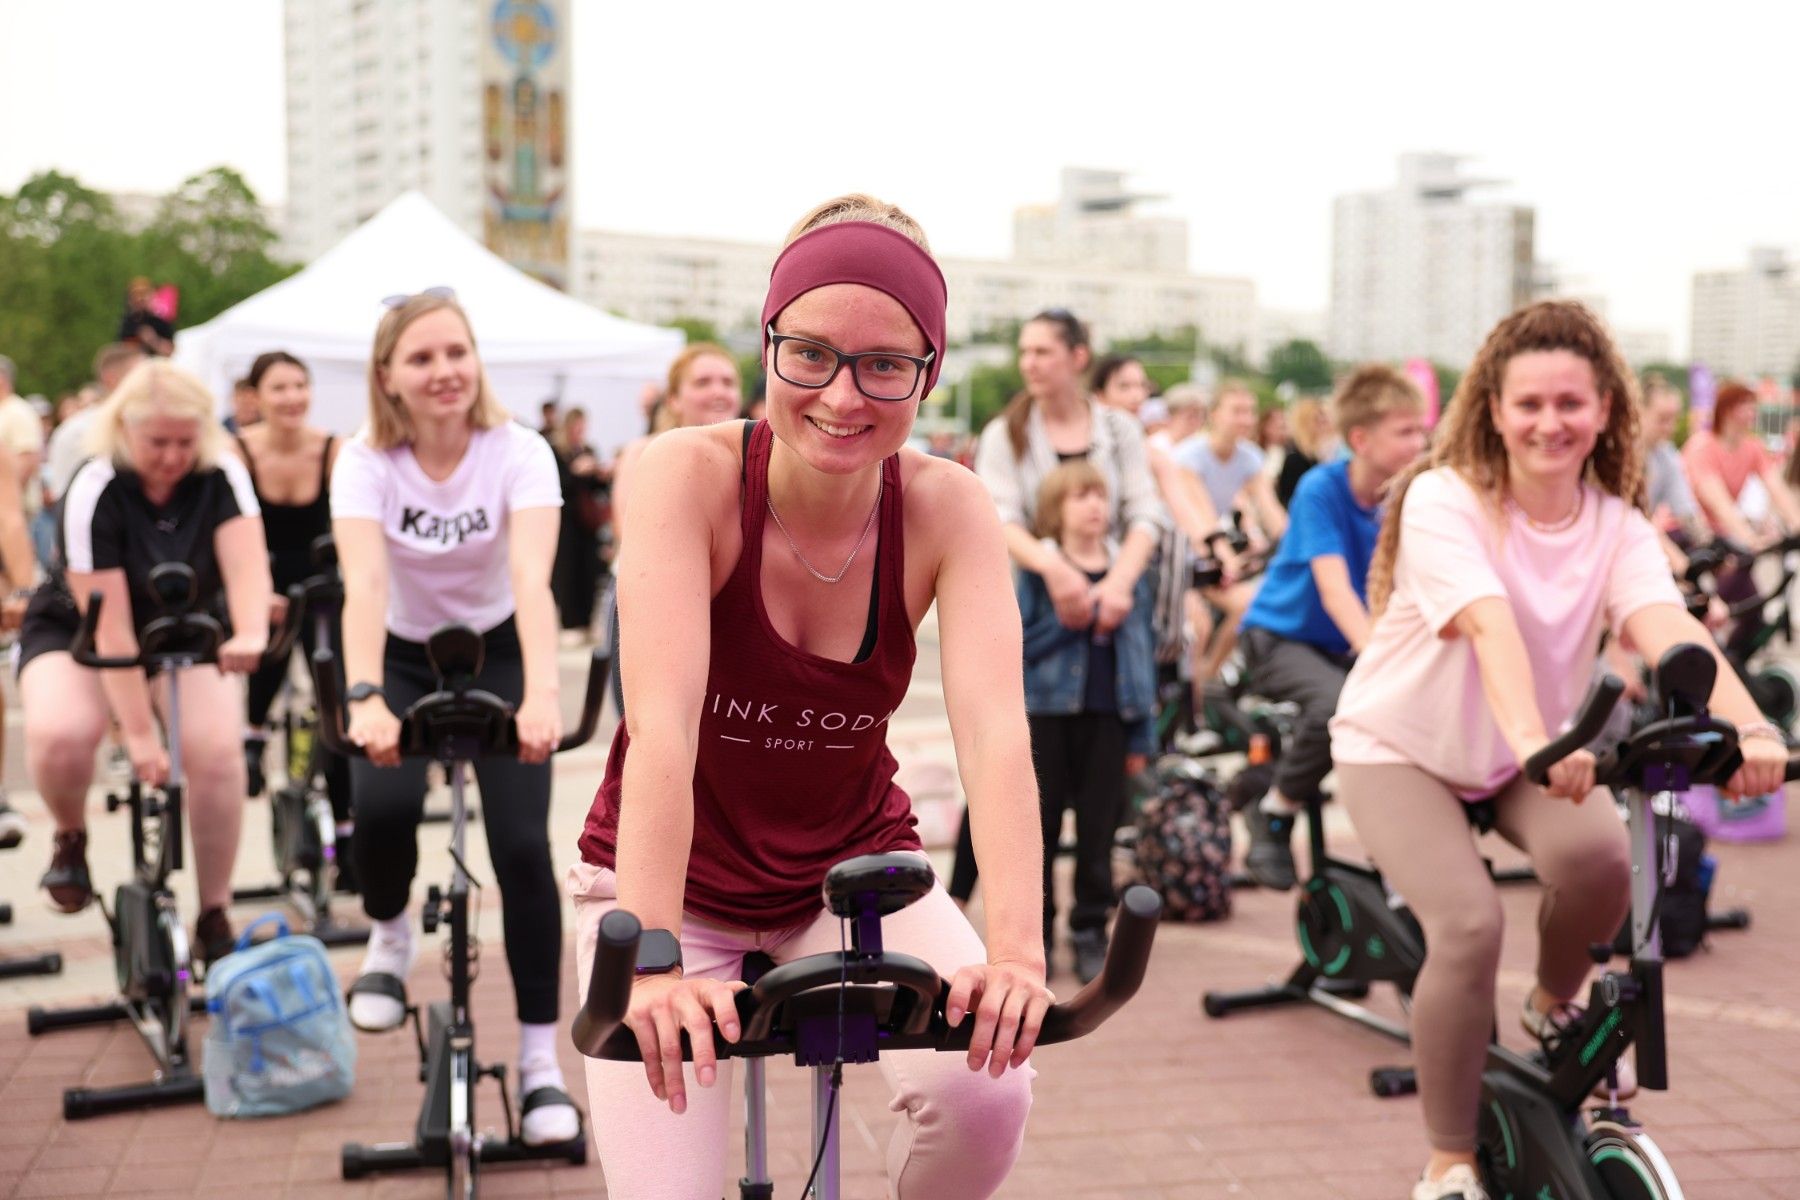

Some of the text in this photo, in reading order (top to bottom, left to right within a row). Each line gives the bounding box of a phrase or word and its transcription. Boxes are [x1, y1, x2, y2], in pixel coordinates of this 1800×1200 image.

[401, 507, 489, 544] Kappa
[713, 694, 778, 724] INK
[764, 737, 814, 751] SPORT
